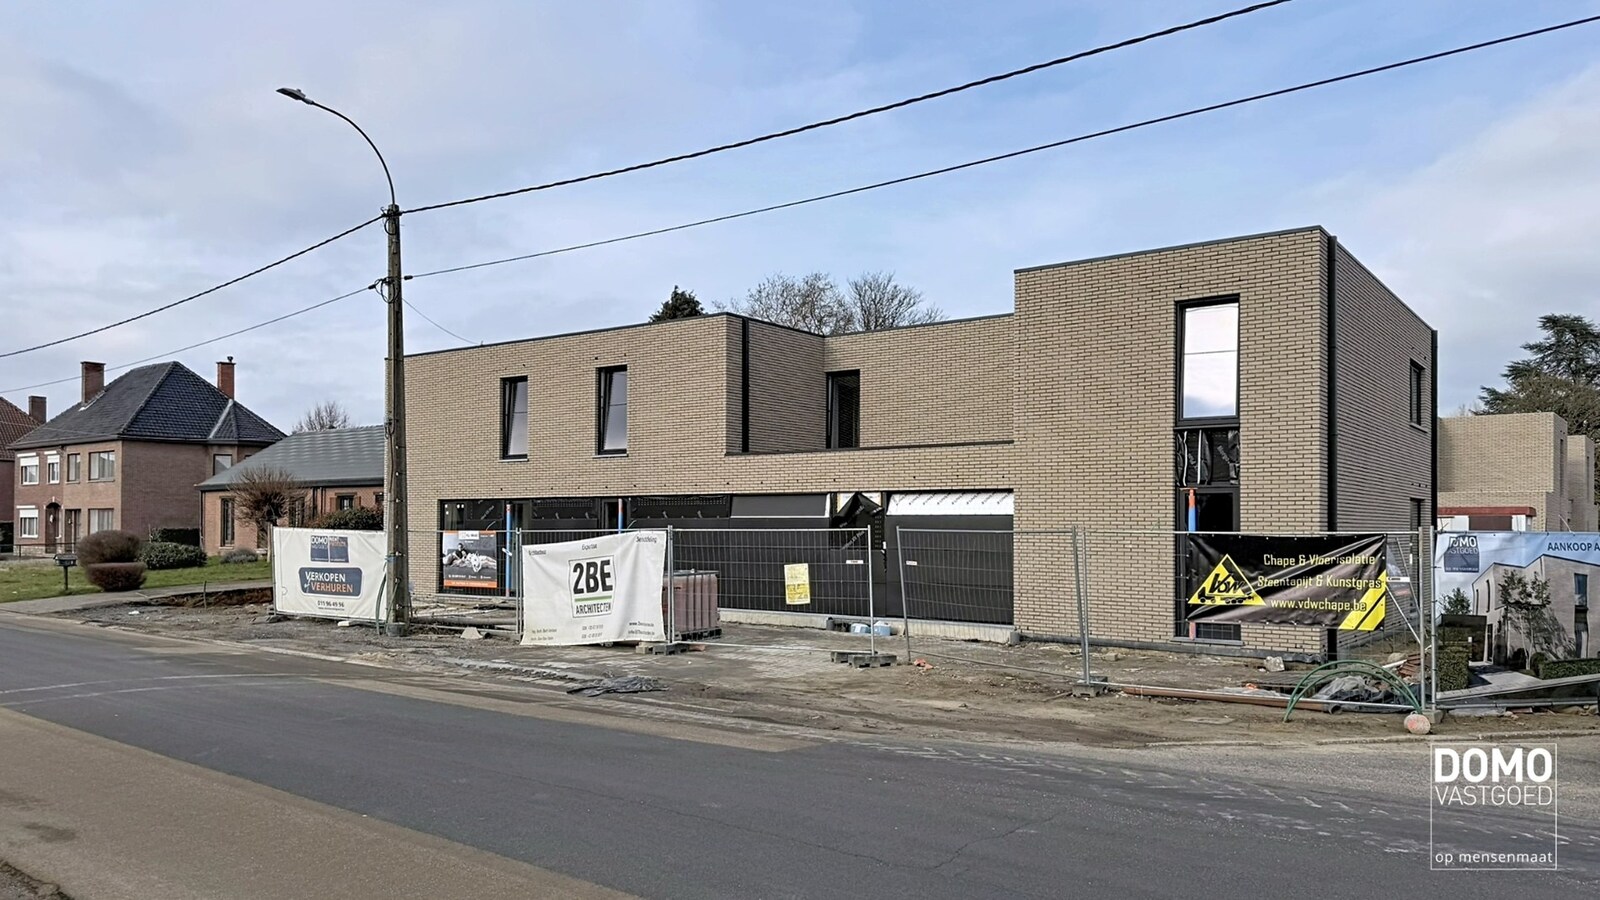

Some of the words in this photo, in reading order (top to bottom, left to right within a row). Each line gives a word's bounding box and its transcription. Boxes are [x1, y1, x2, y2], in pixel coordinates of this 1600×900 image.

[1547, 542, 1592, 551] AANKOOP
[1263, 554, 1296, 567] Chape
[1299, 554, 1306, 566] &
[1309, 553, 1376, 565] Vloerisolatie
[305, 571, 346, 582] VERKOPEN
[573, 559, 613, 594] 2BE
[1257, 575, 1313, 589] Steentapijt
[1316, 574, 1323, 586] &
[1326, 575, 1381, 590] Kunstgras
[311, 582, 353, 593] VERHUREN
[576, 602, 611, 615] ARCHITECTEN
[1270, 597, 1367, 612] www.vdwchape.be
